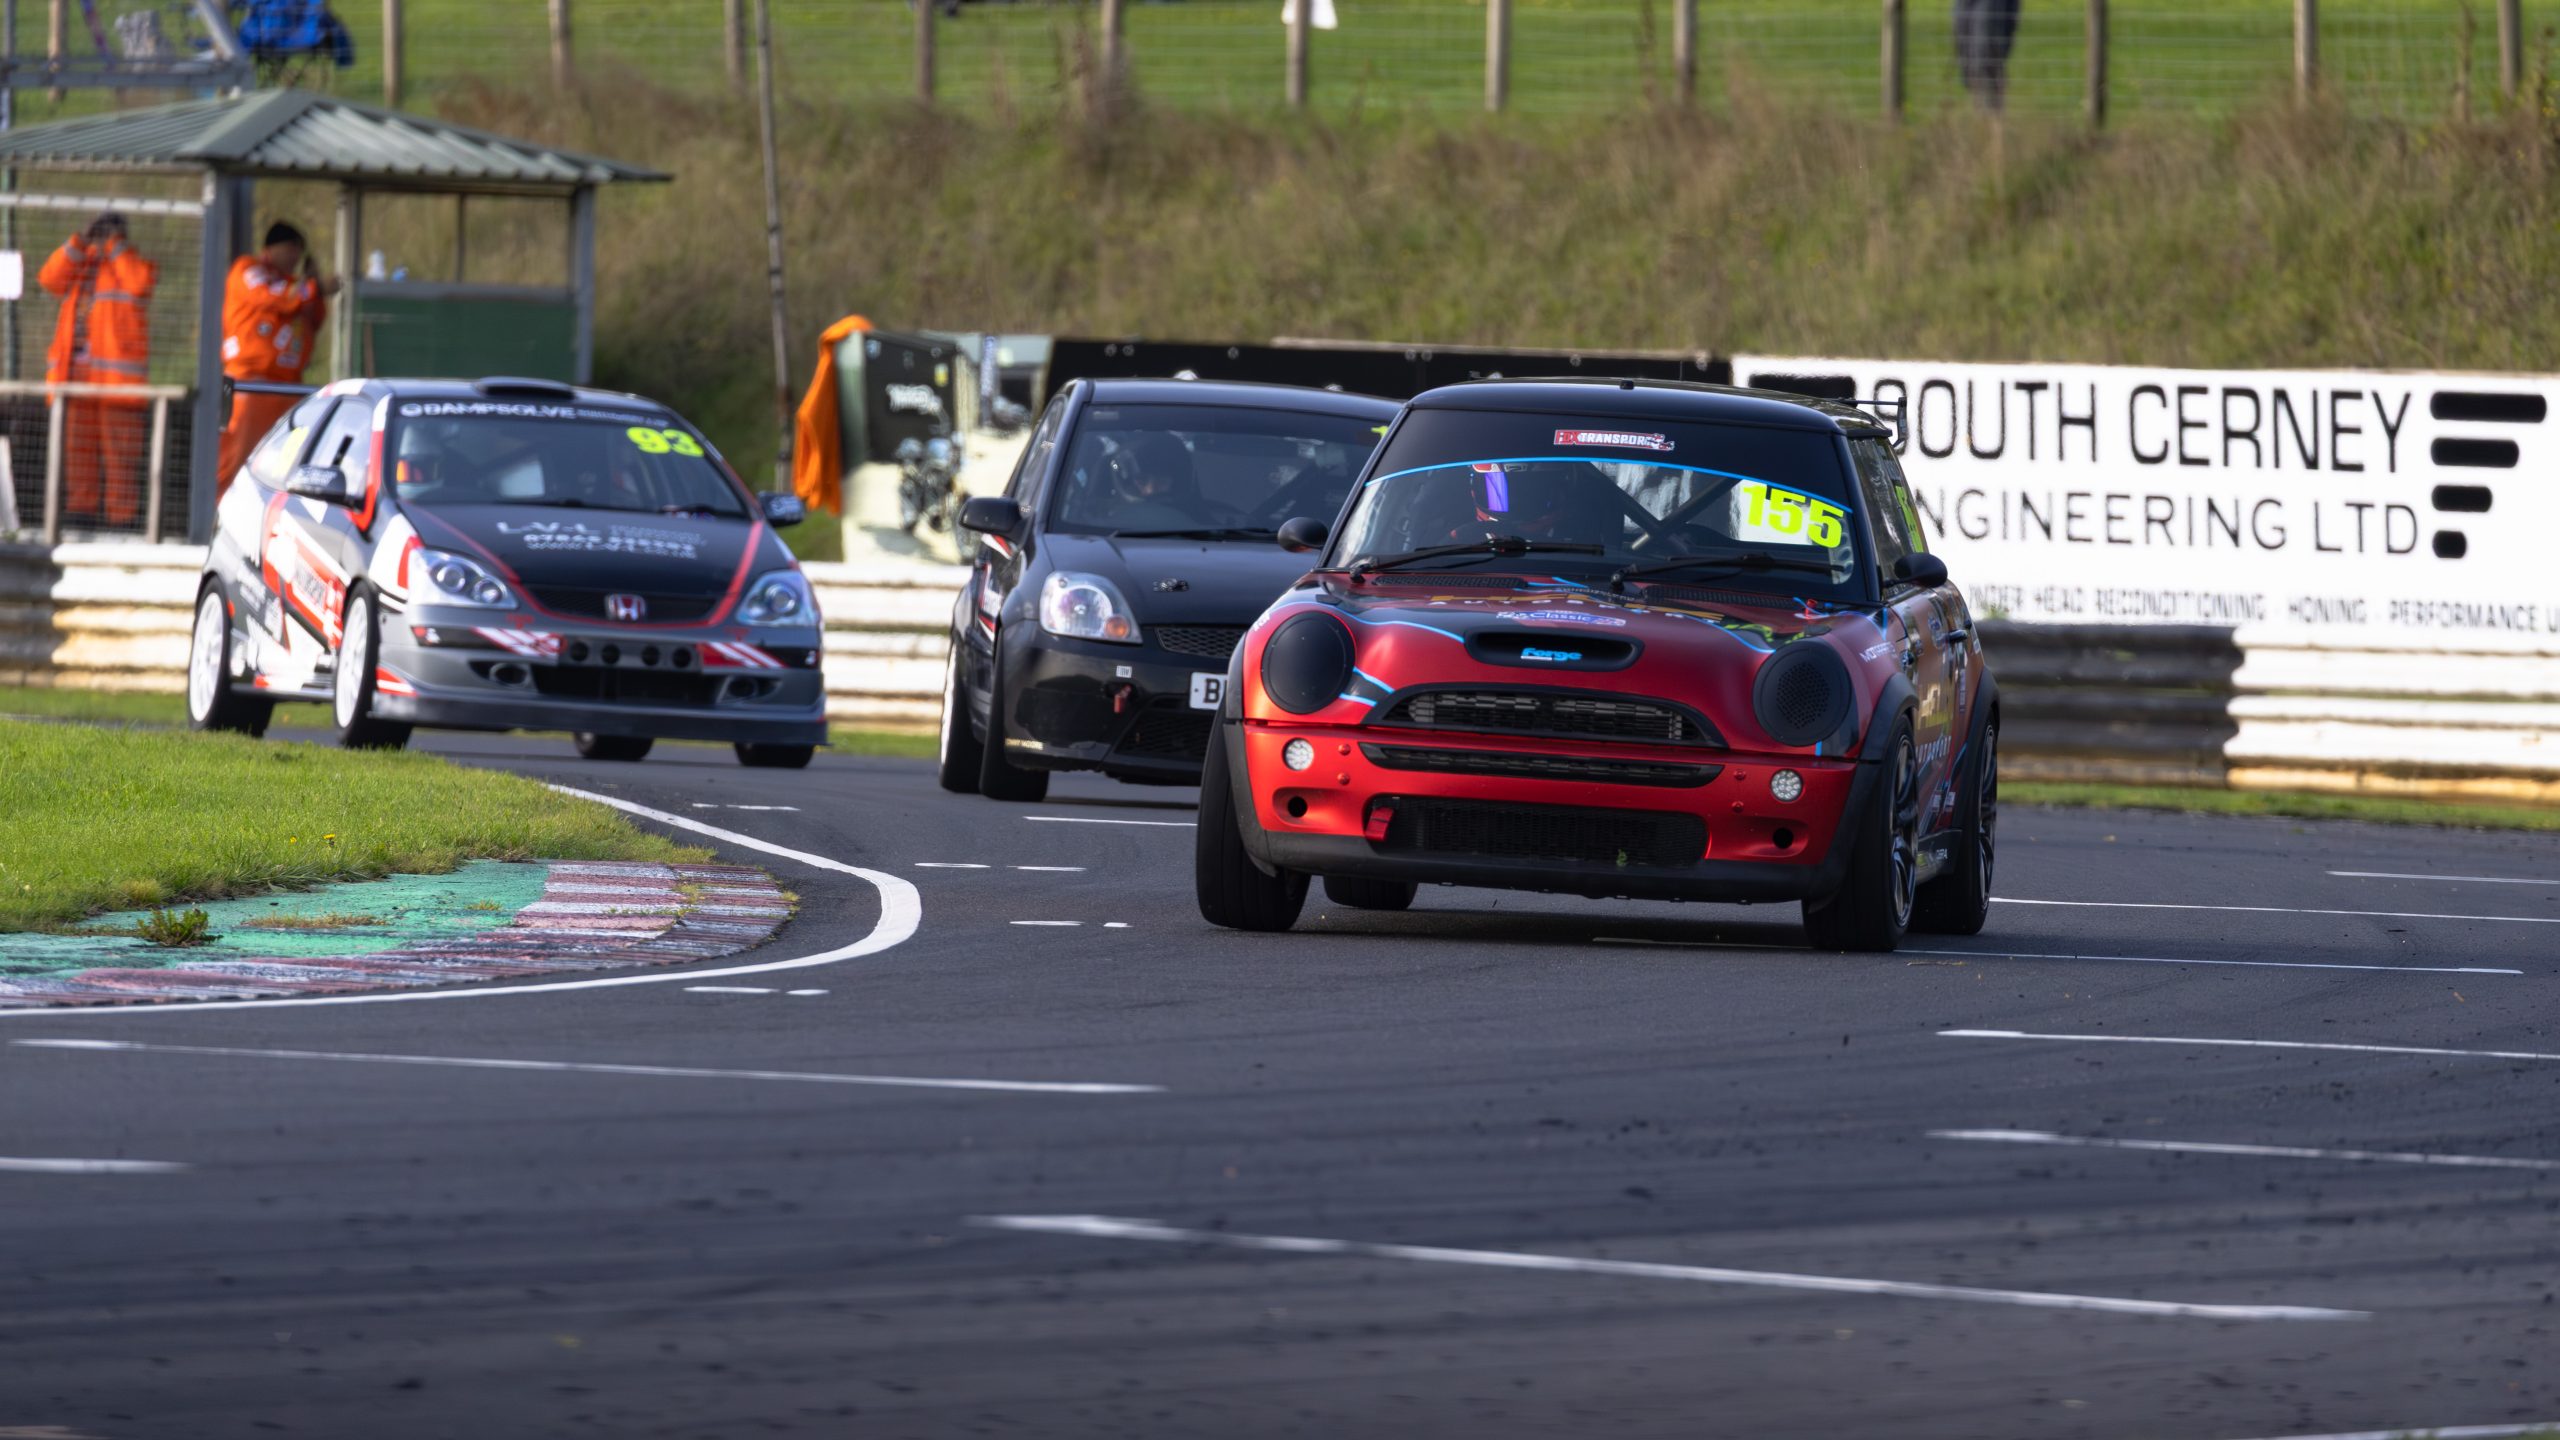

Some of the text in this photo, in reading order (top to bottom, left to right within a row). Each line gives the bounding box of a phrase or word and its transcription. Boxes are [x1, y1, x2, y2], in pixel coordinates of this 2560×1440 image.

[626, 426, 704, 457] 93
[1873, 378, 2411, 473] SOUTH CERNEY
[1743, 484, 1845, 548] 155
[1914, 487, 2287, 551] NGINEERING
[2314, 500, 2418, 555] LTD
[2288, 595, 2368, 625] HONING
[2389, 598, 2538, 632] PERFORMANCE
[1203, 677, 1228, 704] B
